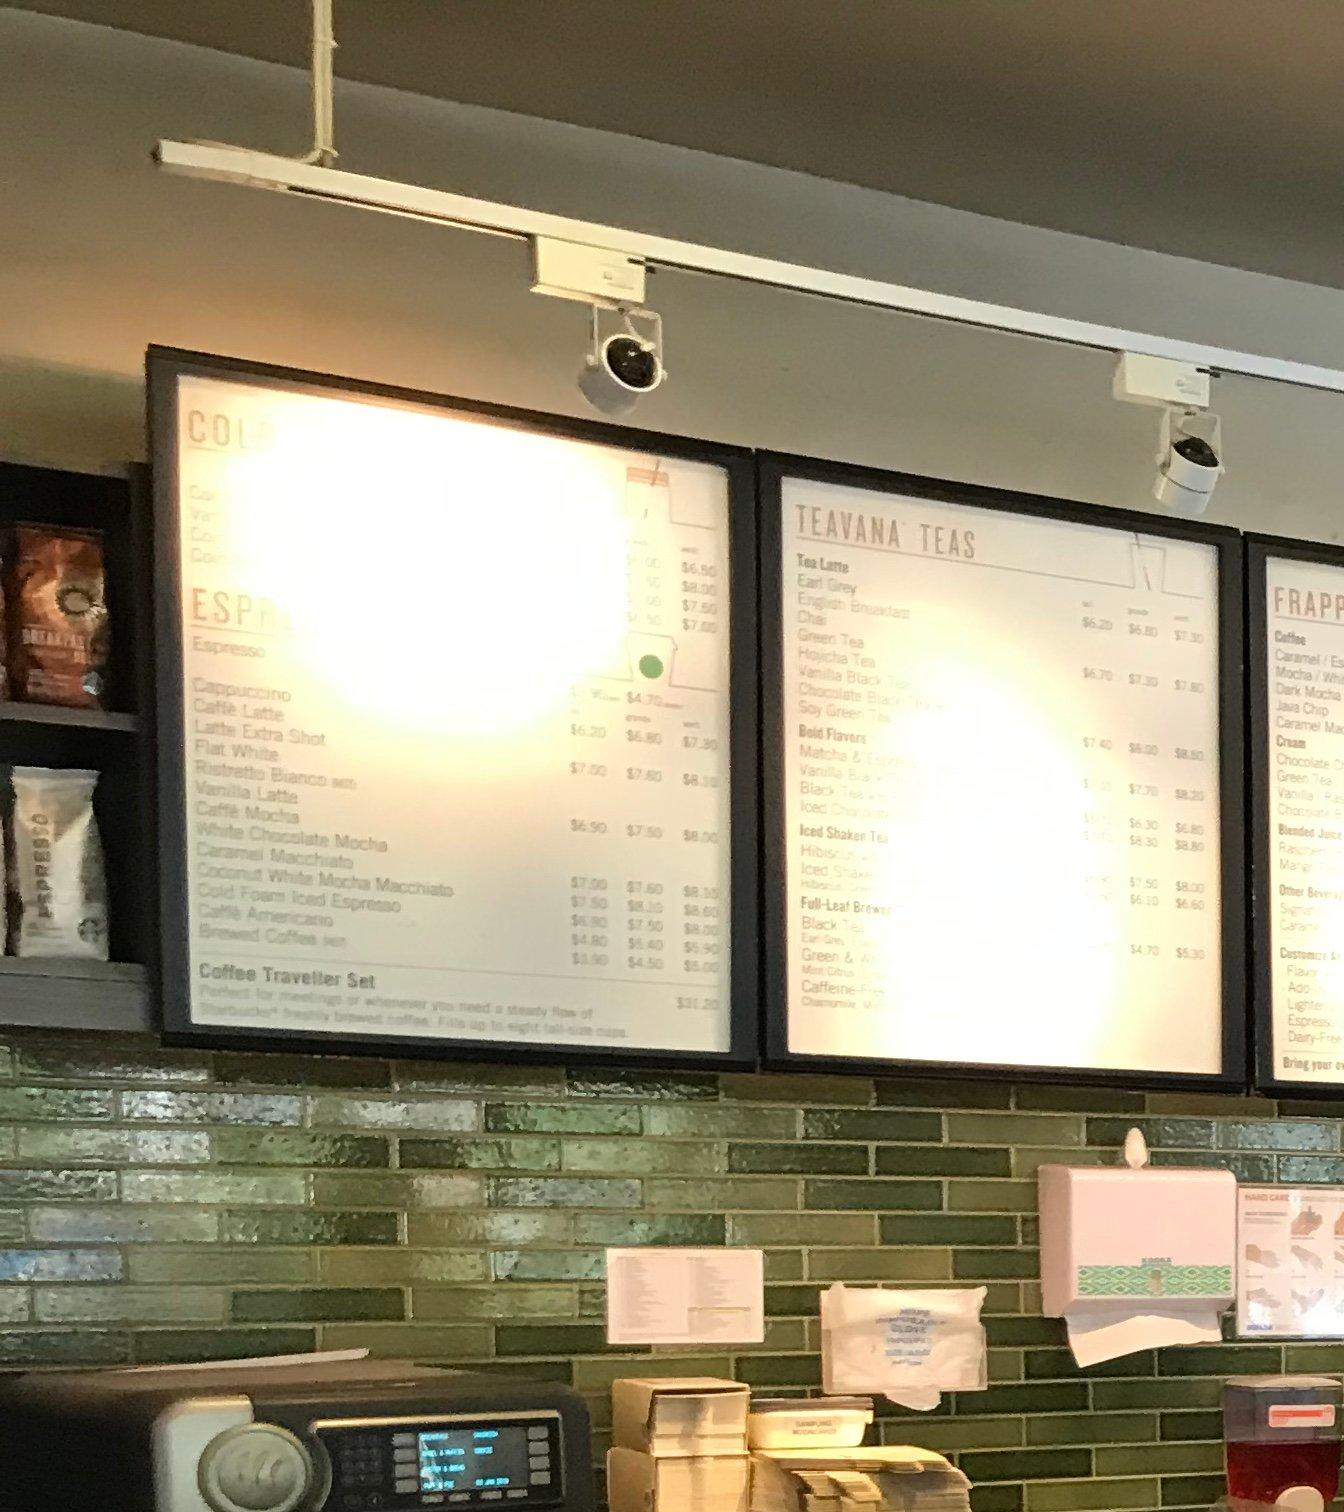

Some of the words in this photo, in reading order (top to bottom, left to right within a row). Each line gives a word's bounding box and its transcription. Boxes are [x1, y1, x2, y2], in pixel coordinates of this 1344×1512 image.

[796, 504, 900, 548] TEAVANA
[920, 523, 976, 560] TEAS
[797, 553, 817, 569] Tea
[820, 557, 849, 574] Latte
[797, 573, 822, 590] Earl
[827, 578, 858, 596] Grey
[798, 592, 845, 610] English
[798, 610, 828, 627] Chai
[798, 628, 836, 645] Green
[840, 633, 865, 649] Tea
[1274, 630, 1307, 647] Coffee
[1275, 649, 1321, 667] Caramel
[847, 670, 882, 686] Black
[1275, 666, 1312, 682] Mocha
[193, 677, 291, 702] Cappuccino
[799, 681, 862, 702] Chocolate
[1275, 682, 1300, 698] Dark
[1305, 685, 1342, 702] Mocha
[240, 704, 286, 722] Latte
[799, 699, 823, 718] Soy
[1302, 701, 1330, 718] Chip
[195, 719, 237, 736] Latte
[242, 724, 284, 741] Extra
[288, 728, 327, 746] Shot
[1276, 715, 1322, 733] Caramel
[798, 723, 823, 740] Bold
[826, 727, 867, 745] Flavors
[1276, 733, 1307, 750] Cream
[195, 739, 225, 756] Flat
[231, 744, 279, 761] White
[799, 744, 848, 763] Matcha
[1276, 751, 1330, 771] Chocolate
[270, 767, 327, 787] Bianco
[1276, 769, 1309, 785] Green
[256, 787, 299, 804] Latte
[245, 805, 300, 824] Mocha
[800, 800, 828, 815] Iced
[249, 825, 330, 847] Chocolate
[335, 833, 388, 853] Mocha
[799, 823, 824, 839] Iced
[826, 826, 867, 842] Shaken
[197, 842, 264, 862] Caramel
[270, 848, 354, 870] Macchiato
[268, 868, 314, 886] White
[318, 871, 371, 890] Mocha
[375, 876, 455, 898] Macchiato
[1279, 884, 1304, 898] Other
[291, 890, 326, 907] Iced
[331, 893, 401, 913] Espresso
[801, 896, 850, 913] Full-Leaf
[248, 905, 334, 927] Americano
[801, 916, 838, 931] Black
[265, 927, 317, 945] Coffee
[801, 947, 840, 962] Green
[199, 962, 257, 983] Coffee
[262, 966, 342, 987] Traveller
[346, 972, 376, 990] Set
[1283, 1056, 1309, 1073] Bring
[1311, 1059, 1333, 1074] your
